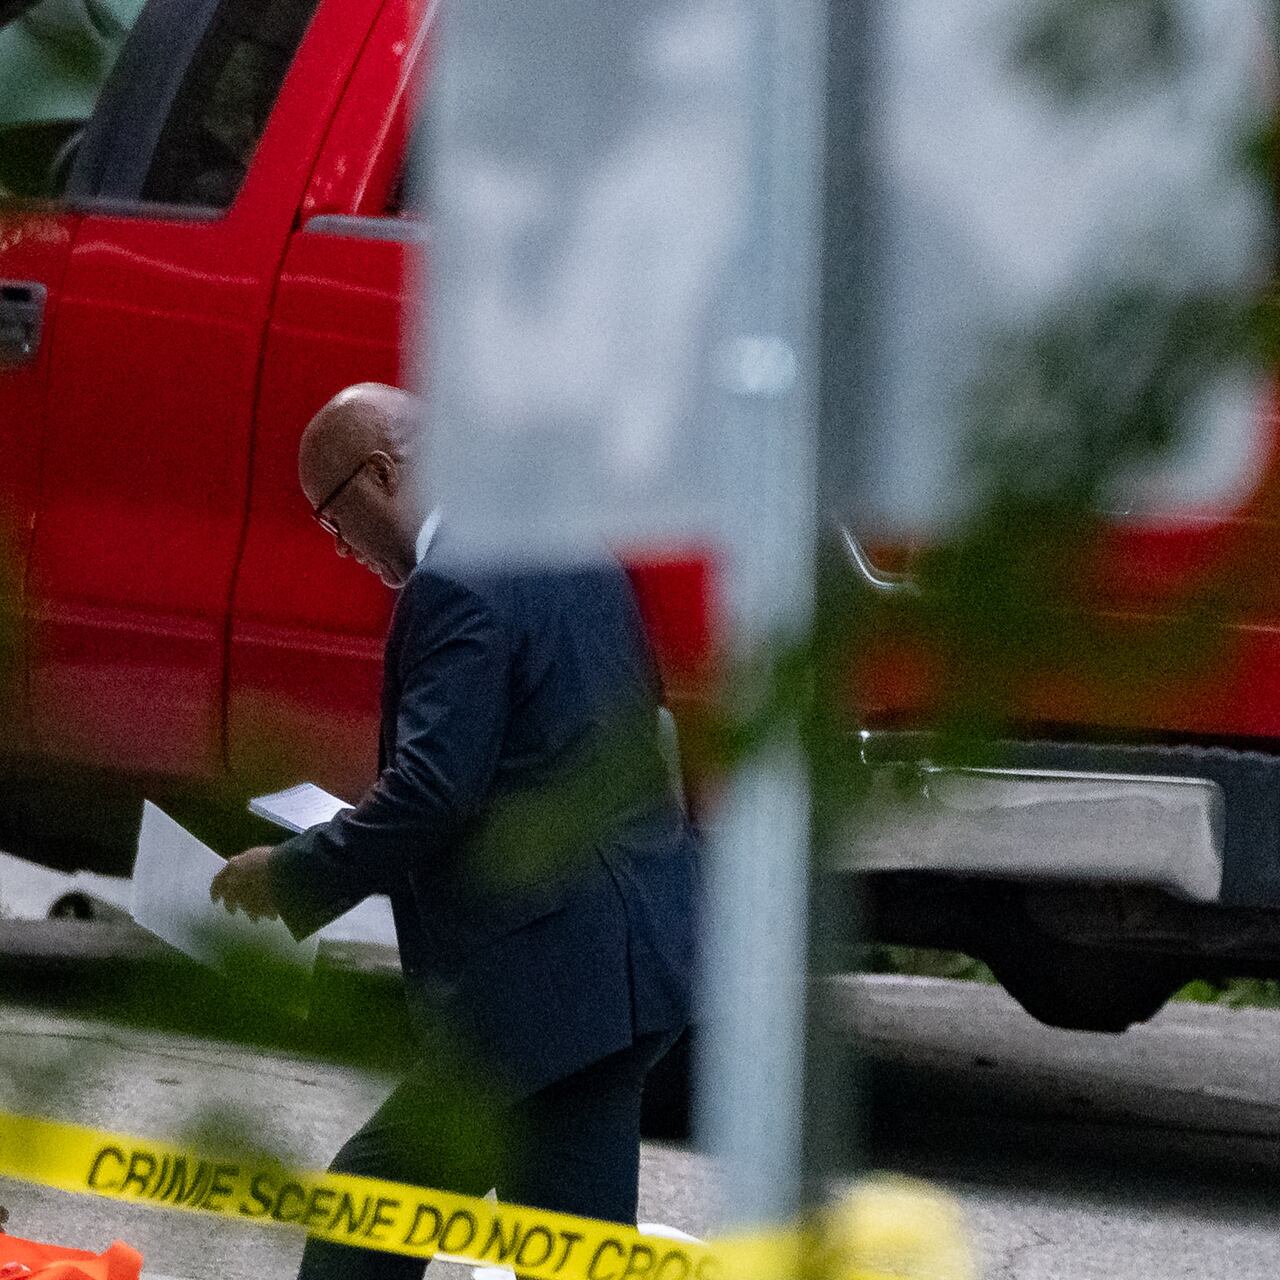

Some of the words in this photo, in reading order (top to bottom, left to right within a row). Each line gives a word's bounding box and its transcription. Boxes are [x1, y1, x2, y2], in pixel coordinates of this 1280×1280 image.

[87, 1146, 241, 1211] CRIME
[239, 1172, 400, 1239] SCENE
[403, 1203, 476, 1253] DO
[478, 1215, 585, 1273] NOT
